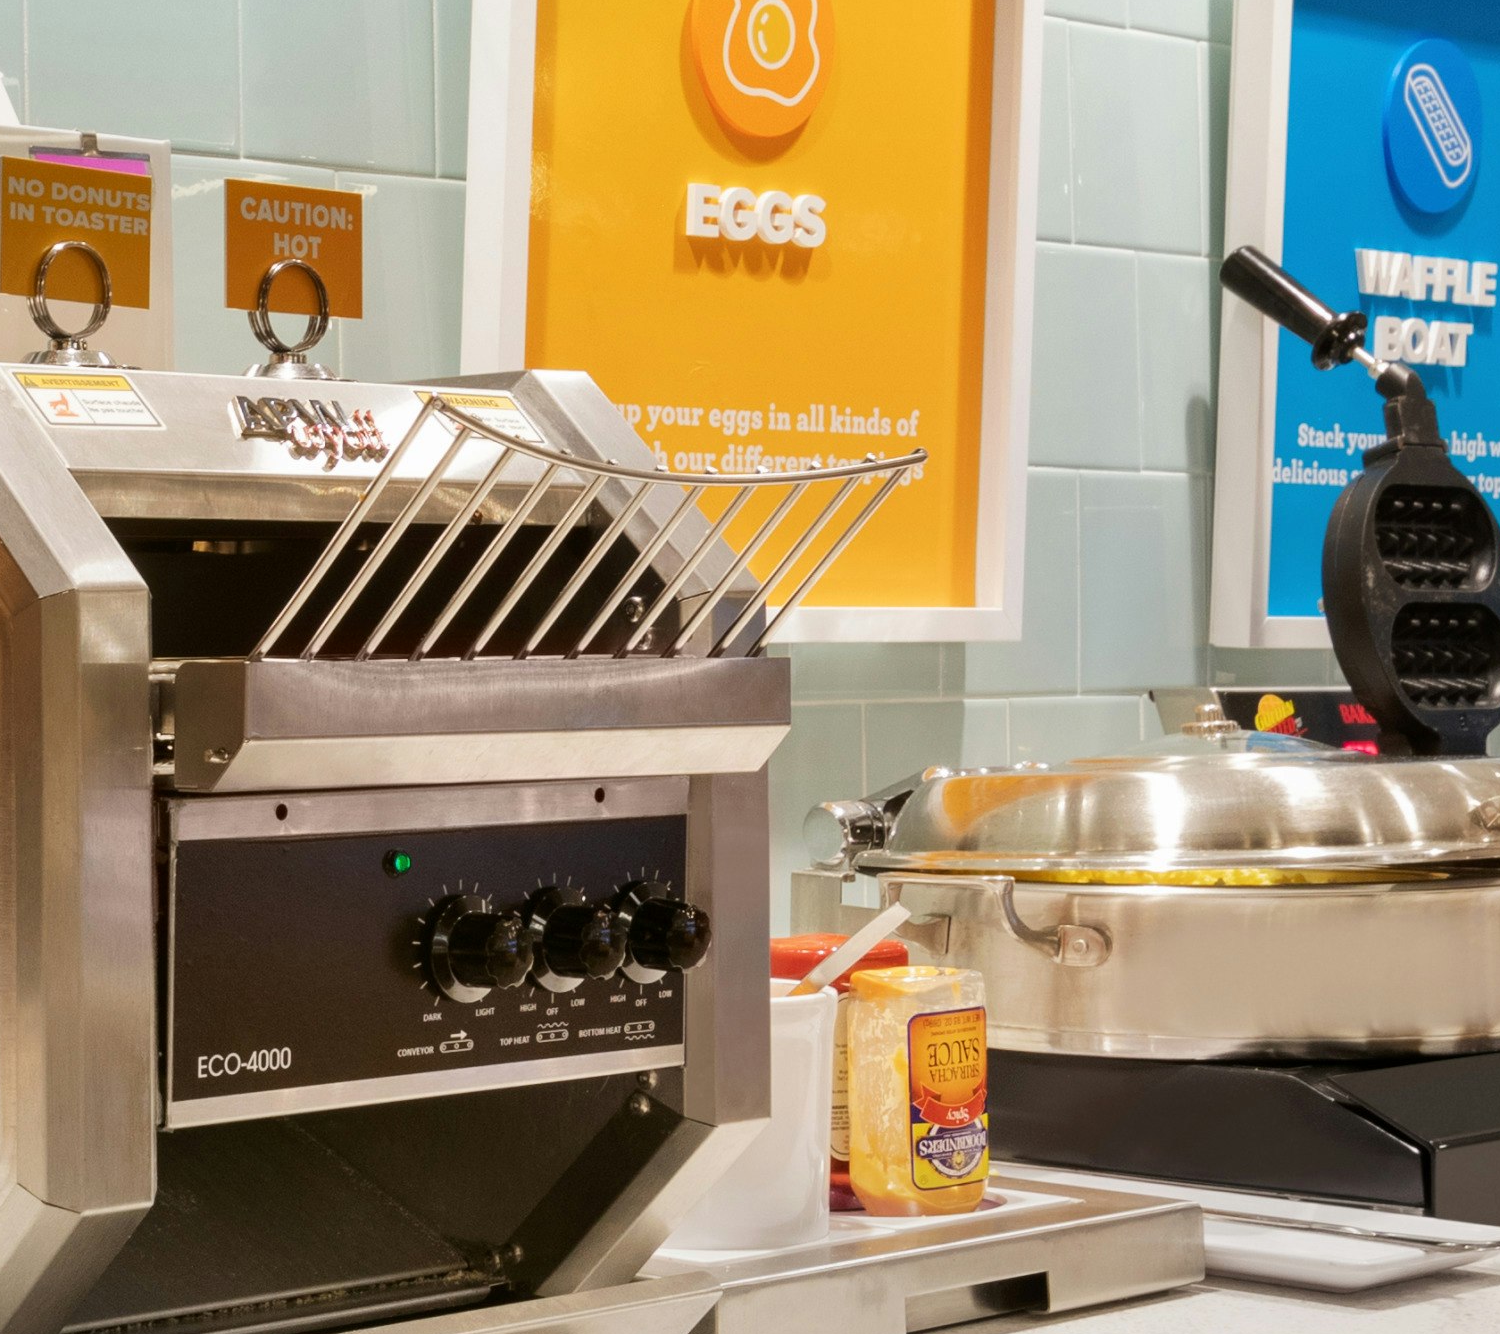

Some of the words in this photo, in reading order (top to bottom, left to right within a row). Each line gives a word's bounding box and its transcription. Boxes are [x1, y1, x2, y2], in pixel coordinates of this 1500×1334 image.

[8, 177, 44, 198] NO
[51, 181, 151, 211] DONUTS
[9, 202, 34, 222] IN
[42, 207, 148, 236] TOASTER
[240, 196, 354, 231] CAUTION:
[686, 182, 826, 248] EGGS
[273, 233, 322, 260] HOT
[1355, 248, 1498, 307] WAFFLE
[1373, 316, 1474, 367] BOAT
[647, 407, 704, 432] your
[709, 408, 763, 436] eggs
[768, 403, 791, 430] in
[796, 404, 825, 433] all
[830, 405, 891, 436] kinds
[896, 410, 921, 437] of
[1298, 422, 1344, 449] Stack
[1452, 431, 1487, 462] high
[674, 450, 716, 471] our
[721, 443, 821, 474] different
[1272, 458, 1348, 486] delicious
[1338, 704, 1377, 724] BAK
[520, 1003, 537, 1012] HIGH
[547, 1007, 559, 1016] OFF
[570, 998, 585, 1007] LOW
[610, 994, 627, 1003] HIGH
[635, 998, 648, 1008] OFF
[659, 989, 673, 998] LOW
[423, 1013, 442, 1022] DARK
[475, 1007, 495, 1017] LIGHT
[500, 1037, 513, 1046] TOP
[513, 1035, 530, 1045] HEAT
[579, 1027, 606, 1038] BOTTOM
[606, 1025, 622, 1035] HEAT
[197, 1047, 292, 1080] ECO-4000
[397, 1045, 434, 1058] CONVEYOR
[927, 1038, 980, 1068] SAUCE
[930, 1063, 980, 1083] SRIRACHA
[946, 1105, 970, 1123] Spicy
